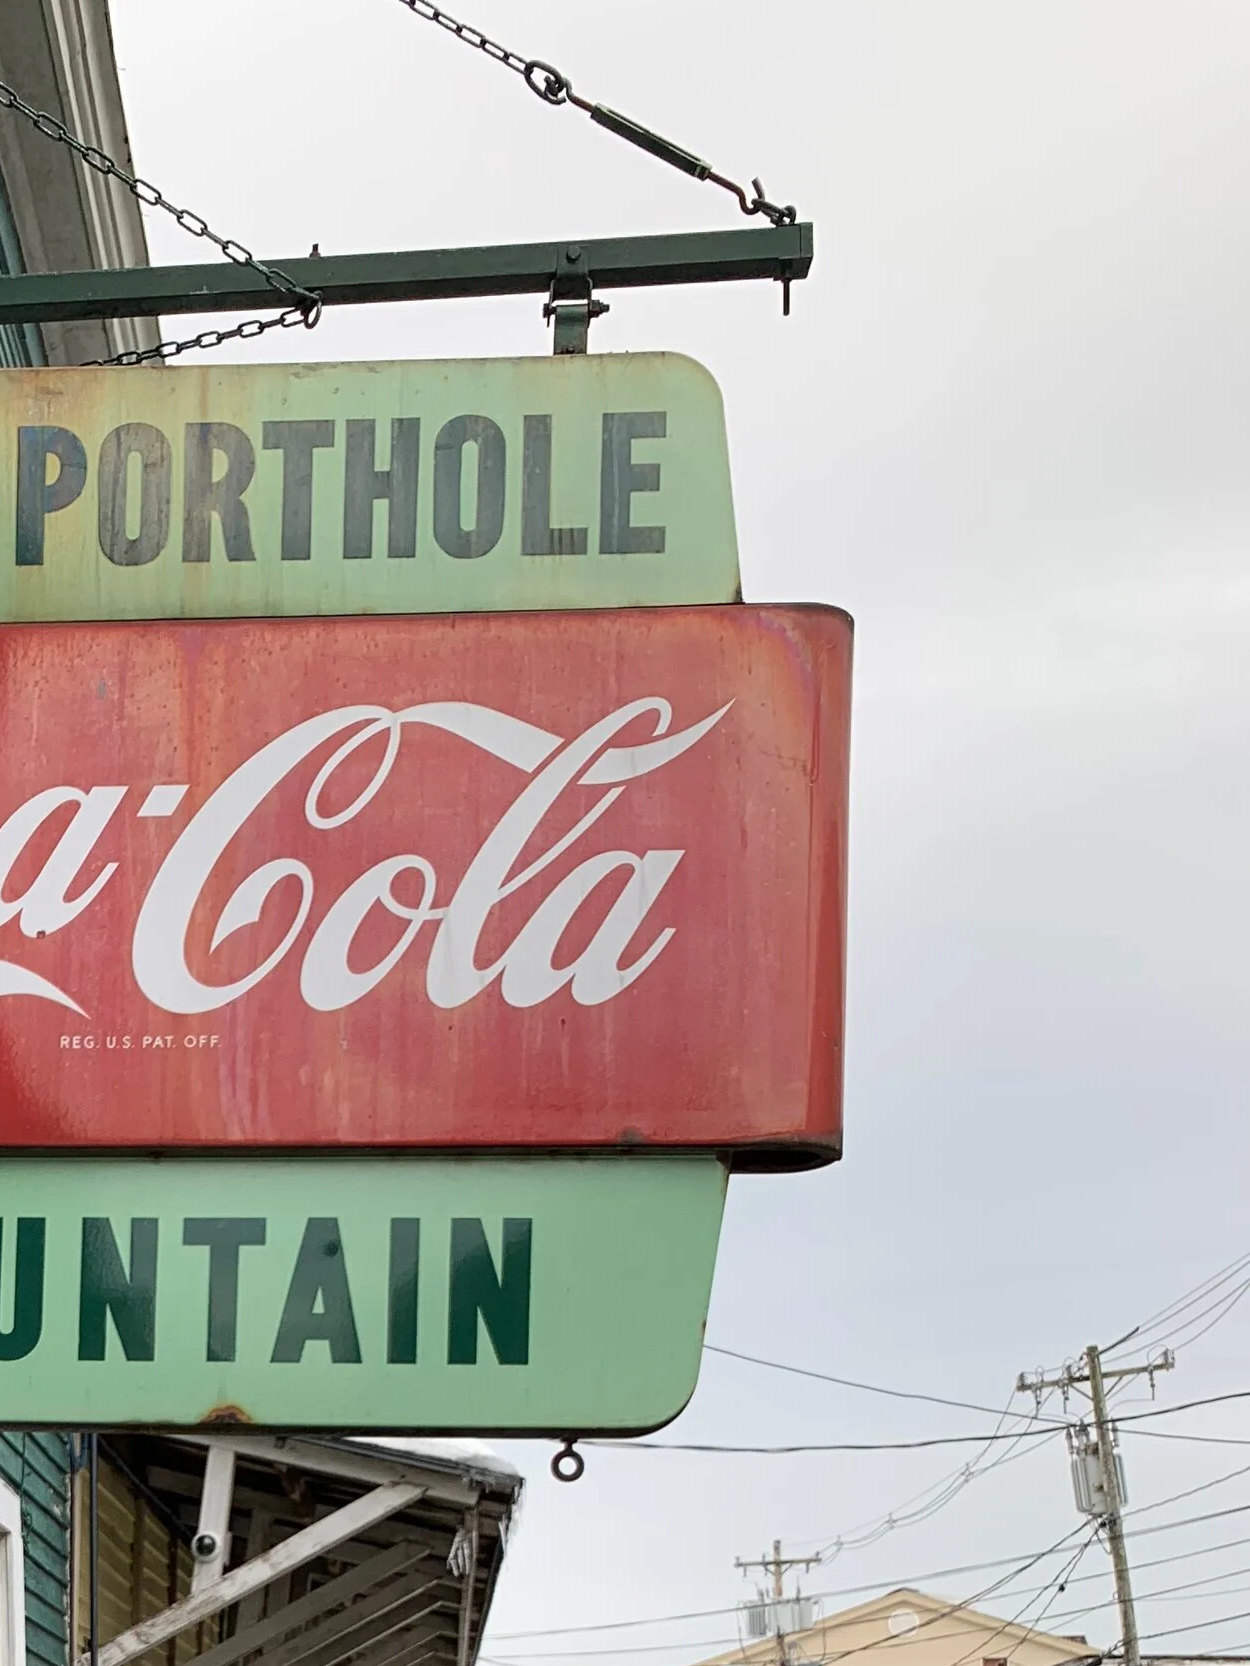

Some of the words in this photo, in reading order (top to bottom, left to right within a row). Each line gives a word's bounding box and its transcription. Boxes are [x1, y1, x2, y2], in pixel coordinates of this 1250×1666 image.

[15, 411, 668, 567] PORTHOLE
[60, 1035, 100, 1049] REG.
[106, 1035, 135, 1049] U.S.
[142, 1035, 178, 1049] PAT.
[184, 1035, 222, 1048] OFF.
